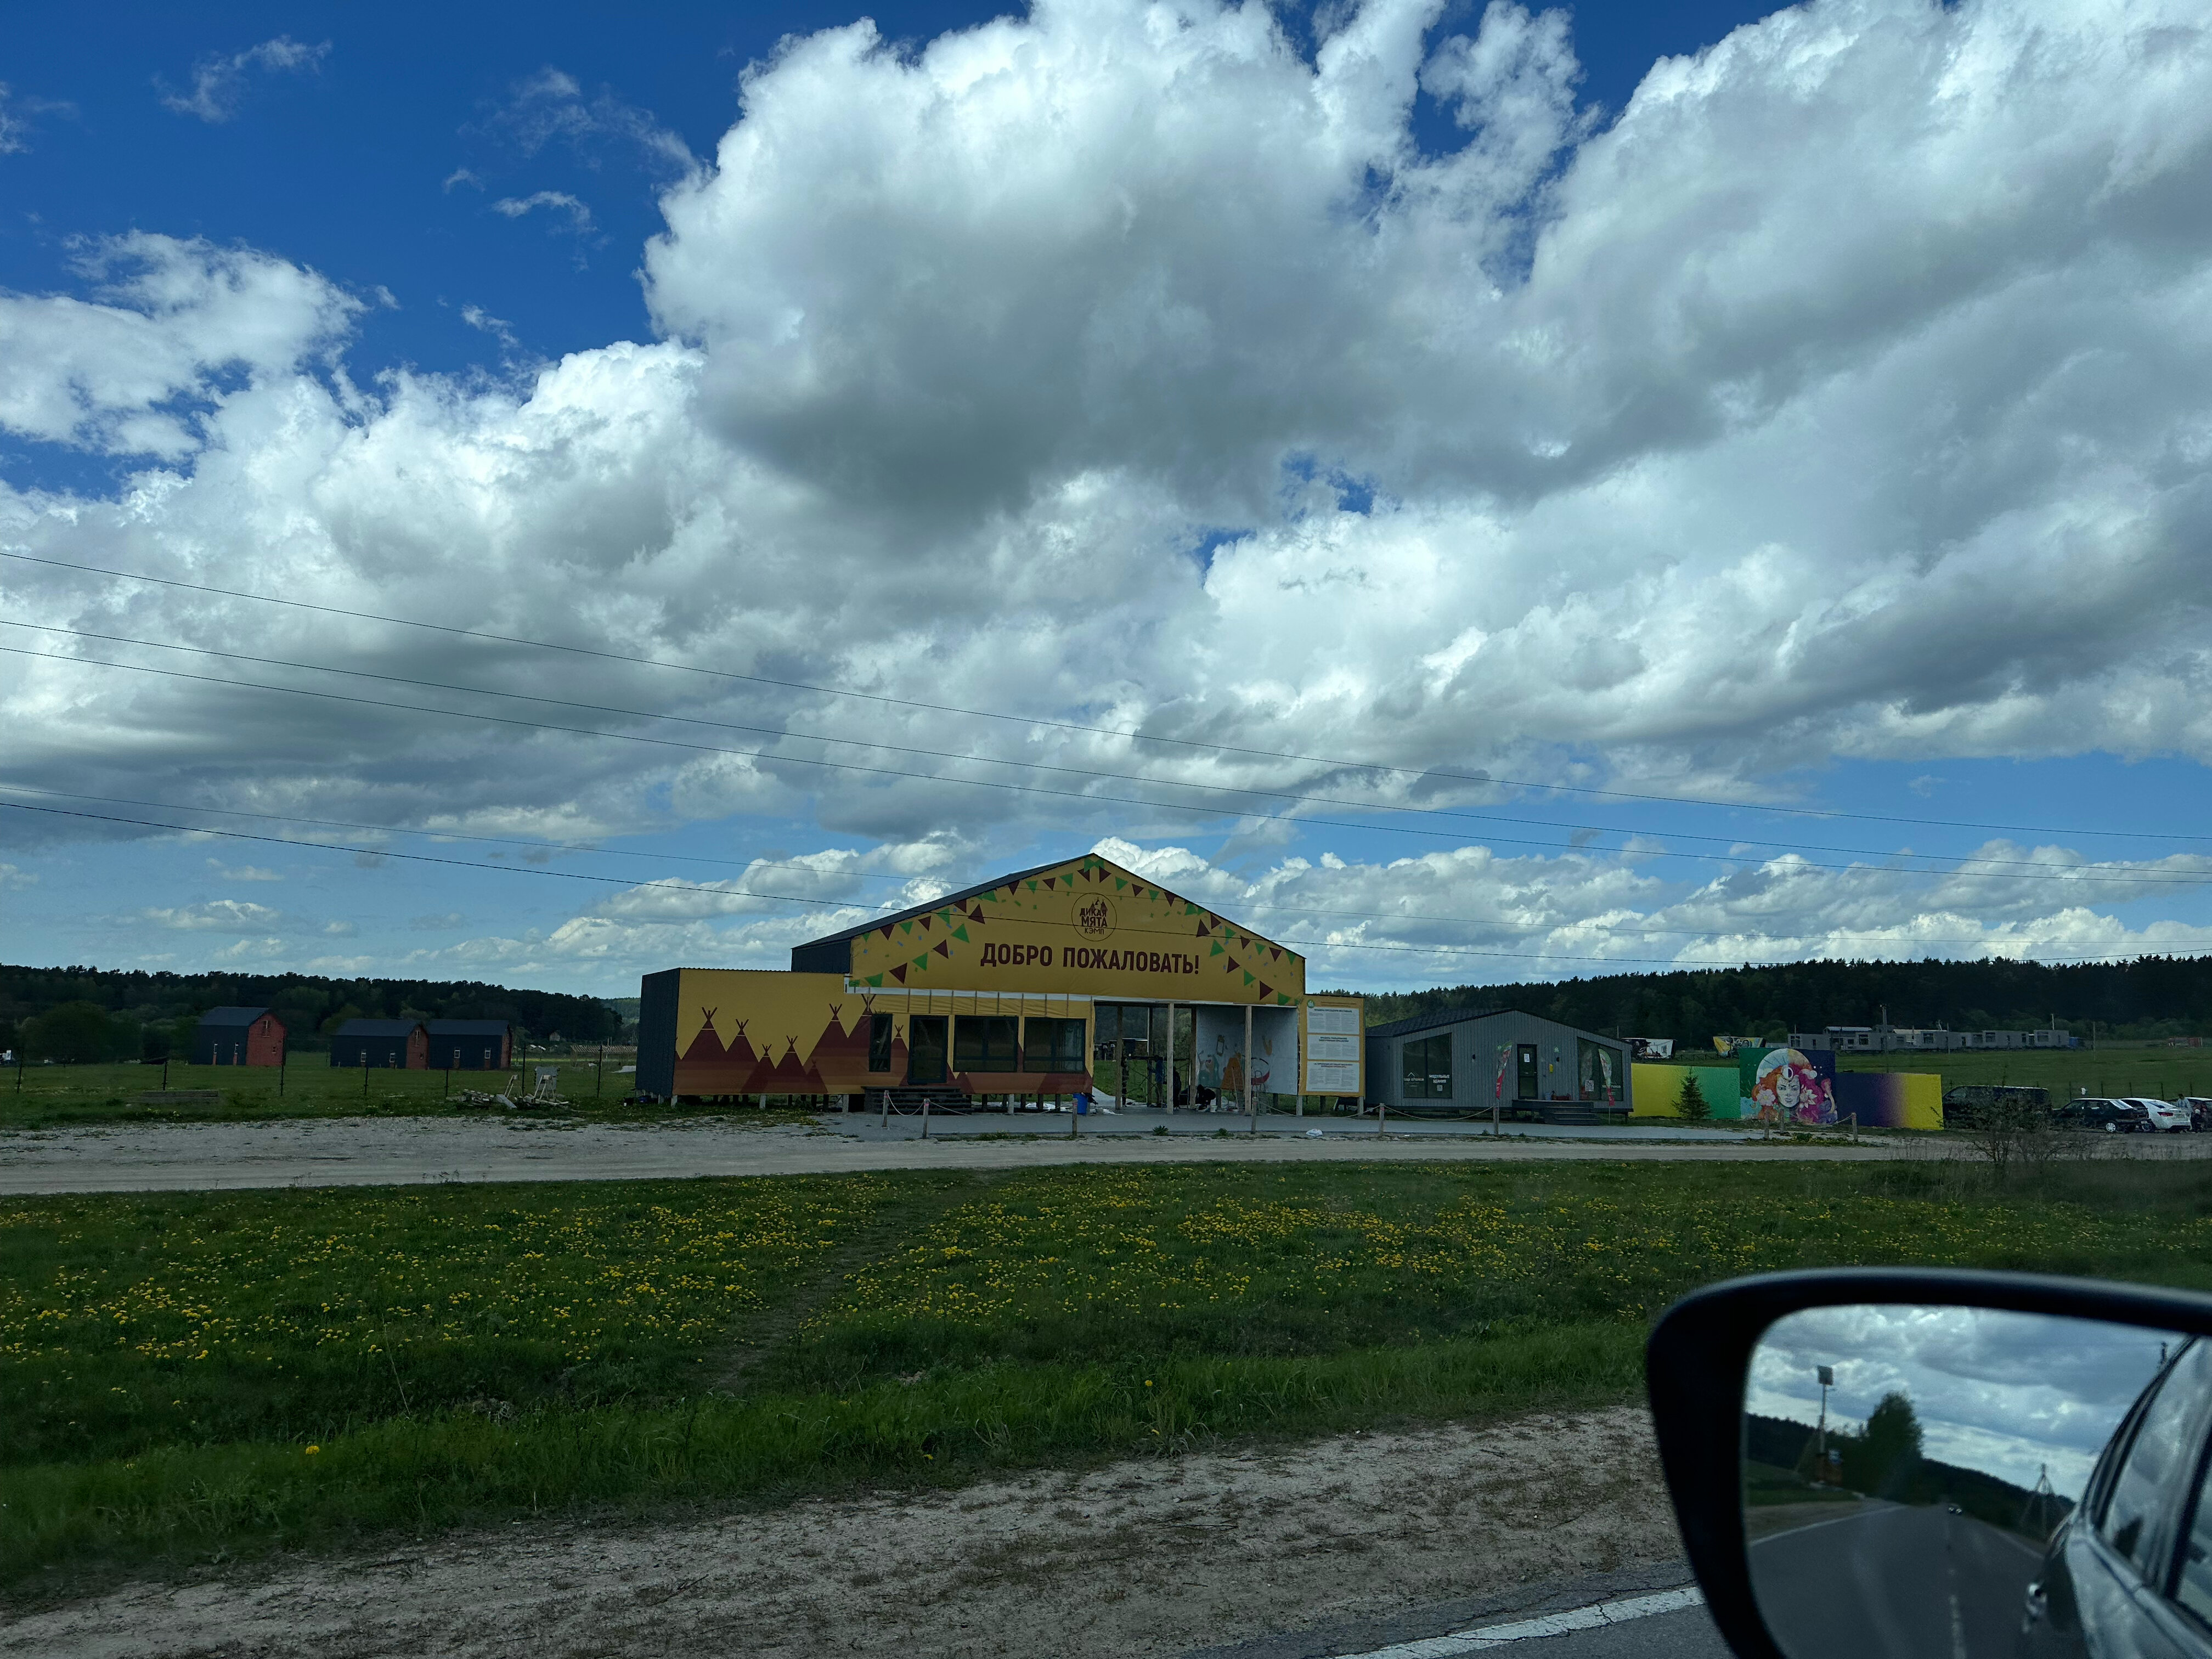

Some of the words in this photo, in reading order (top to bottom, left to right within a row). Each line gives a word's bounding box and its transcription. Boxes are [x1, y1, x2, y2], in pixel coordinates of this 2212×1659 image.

[1079, 908, 1107, 917] ДИКАЯ
[1081, 916, 1108, 927] МЯТА
[980, 943, 1053, 967] ДОБРО
[1063, 947, 1199, 974] ПОЖАЛОВАТЬ!
